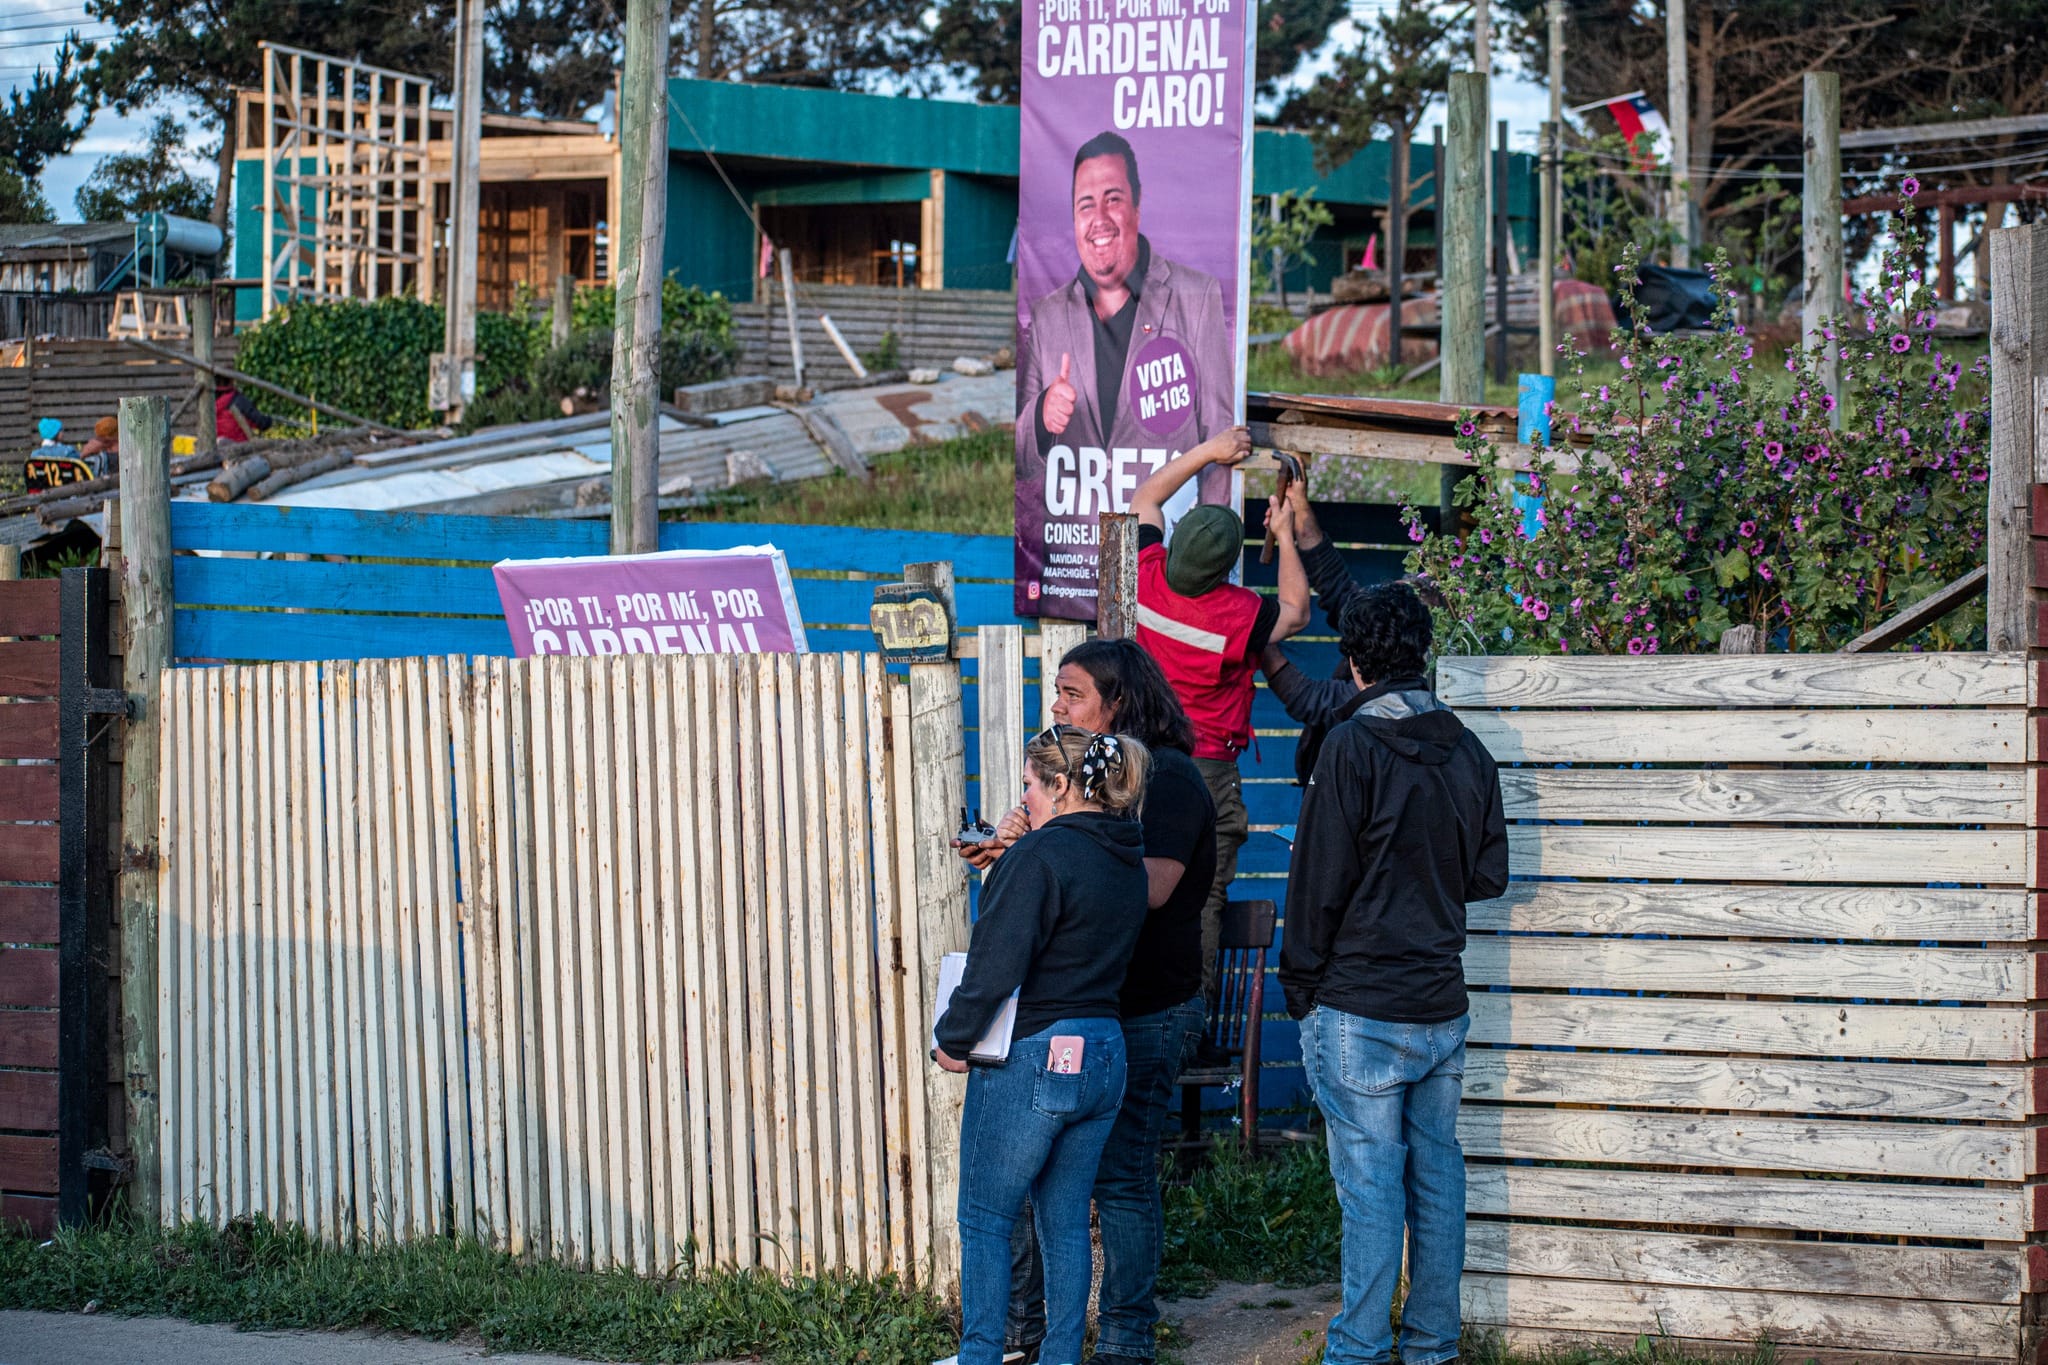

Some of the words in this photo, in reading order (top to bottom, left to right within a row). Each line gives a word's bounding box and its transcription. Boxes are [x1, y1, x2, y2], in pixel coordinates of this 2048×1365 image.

[1038, 0, 1082, 28] ¡POR
[1088, 0, 1110, 24] TI,
[1115, 0, 1152, 19] POR
[1192, 0, 1230, 15] POR
[1037, 18, 1228, 77] CARDENAL
[1114, 73, 1225, 129] CARO!
[1135, 352, 1187, 391] VOTA
[1139, 383, 1191, 420] M-103
[1044, 522, 1100, 545] CONSEJ
[1043, 566, 1091, 579] MARCHIGÜE
[1049, 553, 1083, 564] NAVIDAD
[1042, 584, 1098, 598] @diegogrezcan
[524, 597, 578, 633] ¡POR
[578, 596, 612, 628] TI,
[615, 592, 666, 623] POR
[711, 588, 764, 618] POR
